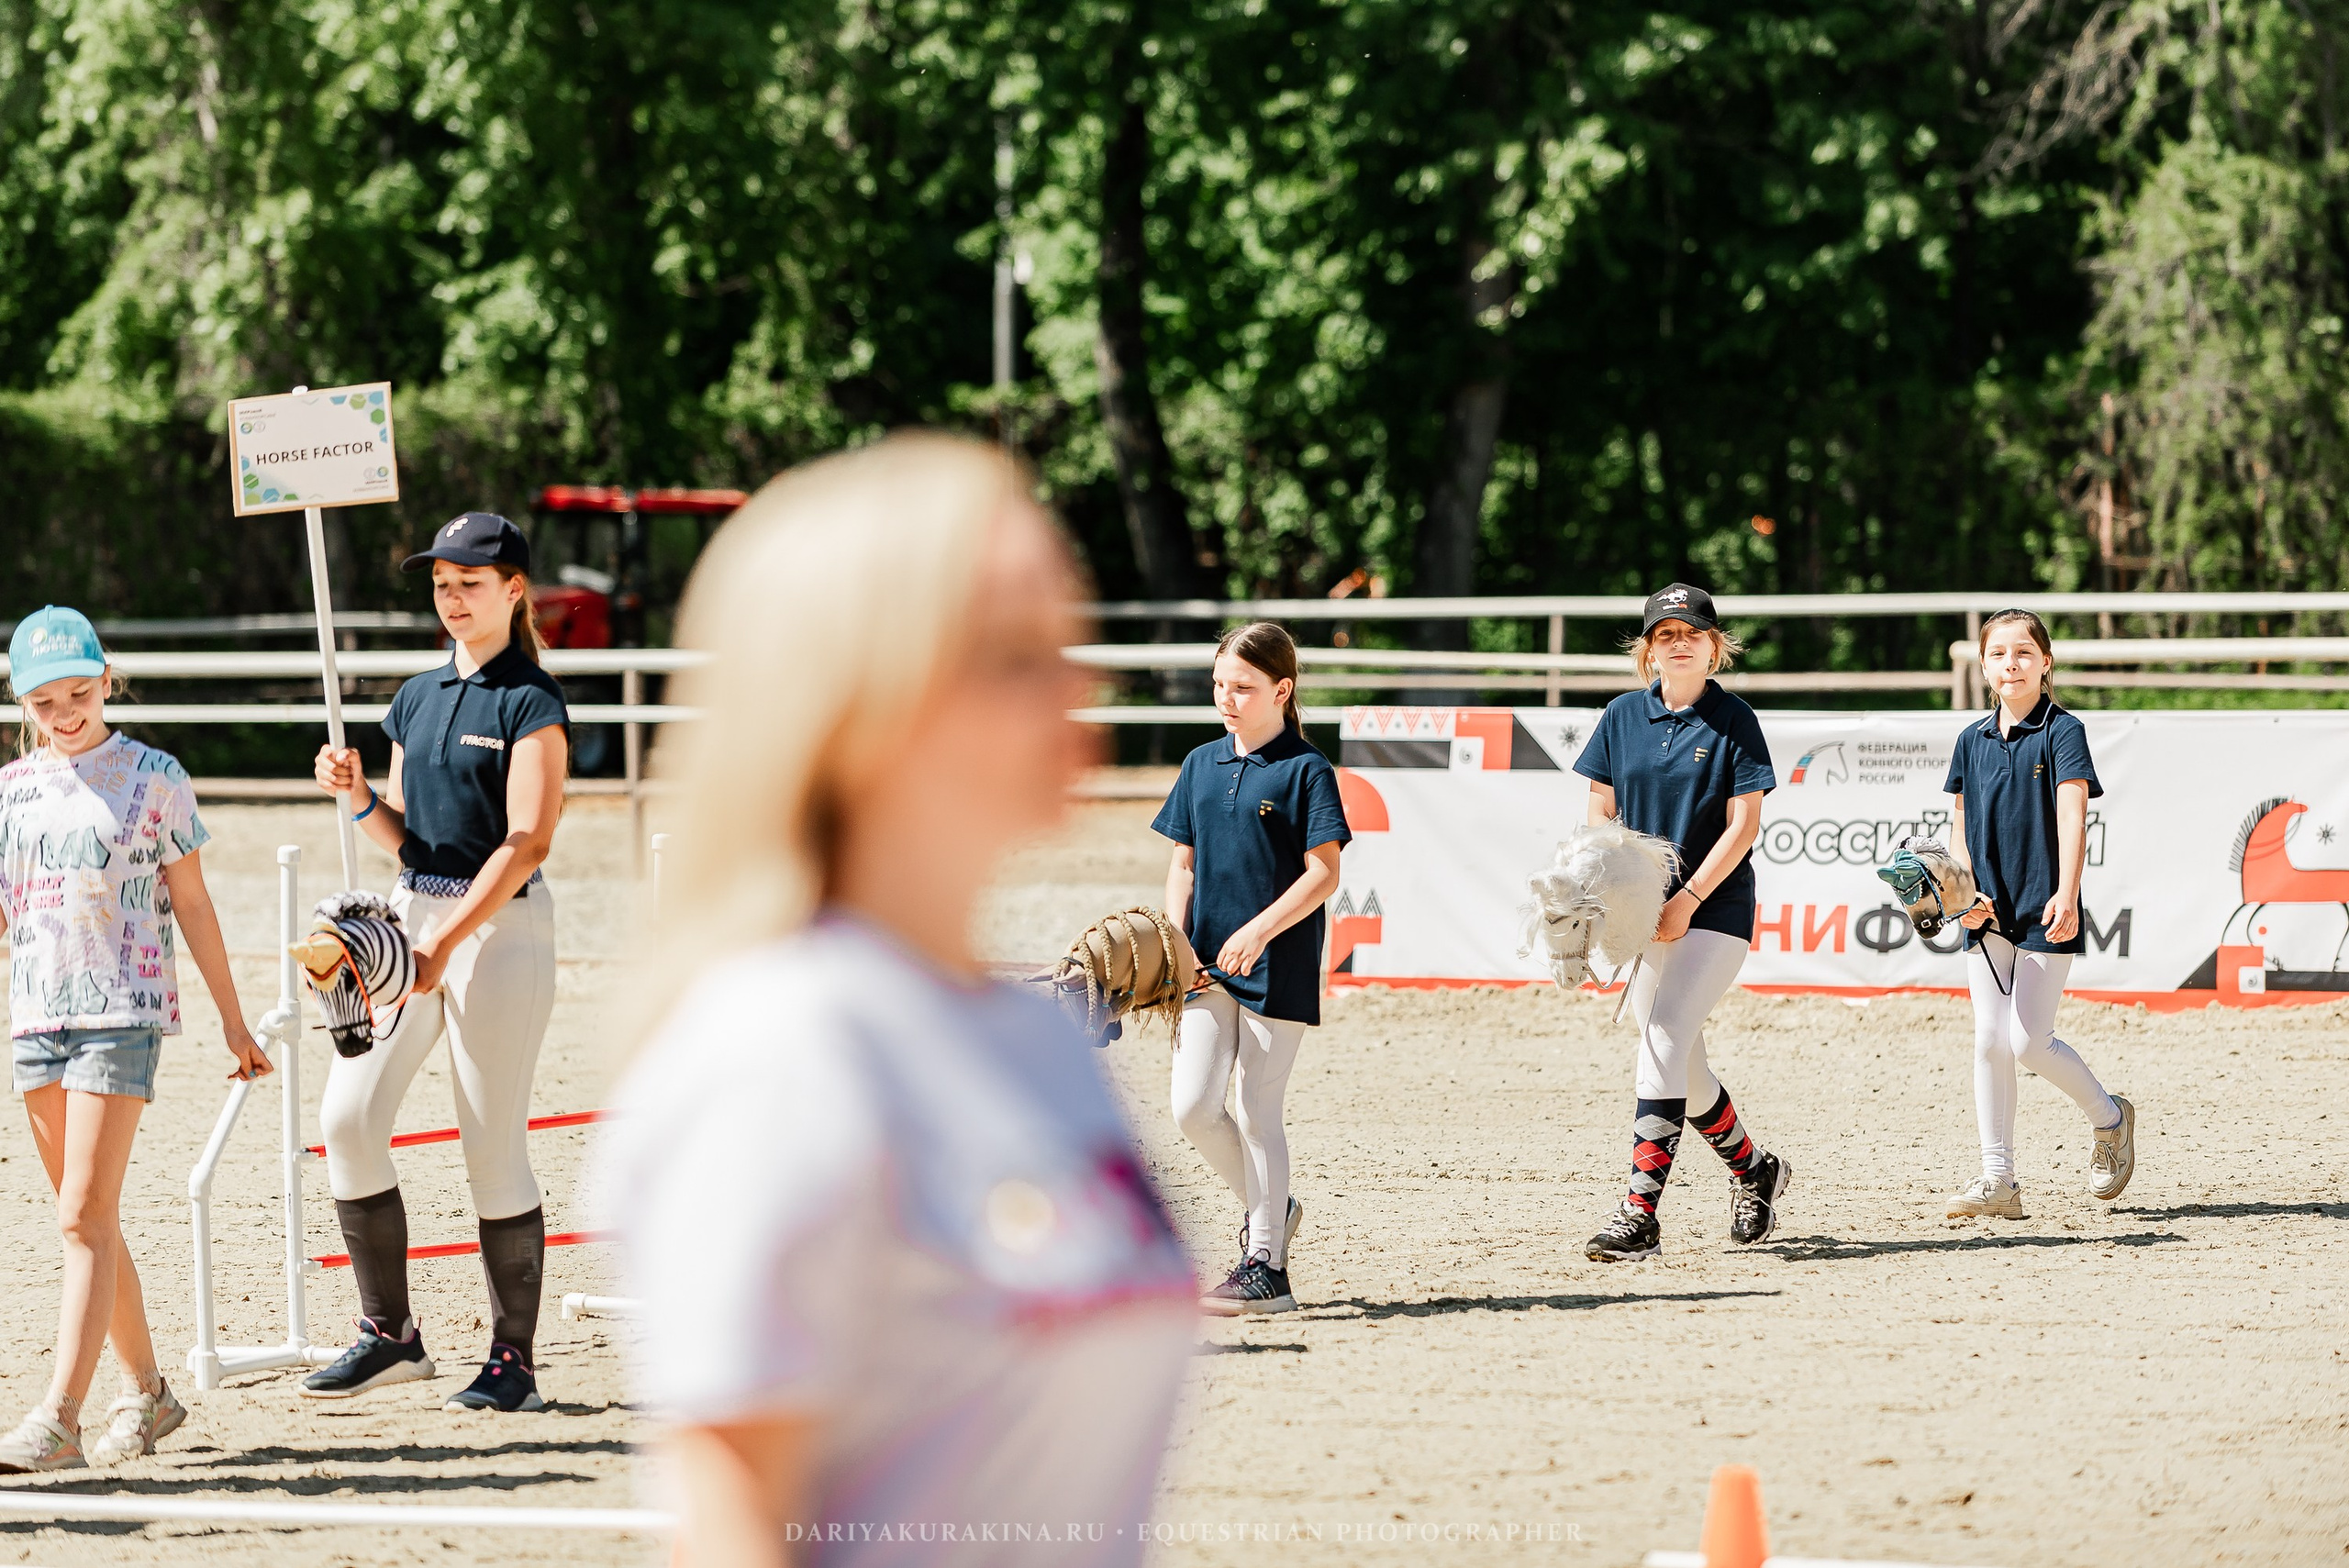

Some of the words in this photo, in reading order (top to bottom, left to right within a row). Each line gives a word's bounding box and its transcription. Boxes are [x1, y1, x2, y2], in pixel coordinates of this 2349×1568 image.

[256, 449, 308, 465] HORSE
[313, 441, 374, 460] FACTOR
[1857, 741, 1928, 755] ФЕДЕРАЦИЯ
[1858, 757, 1913, 769] КОННОГО
[1916, 757, 1952, 769] СПОР
[1858, 773, 1905, 785] РОССИИ
